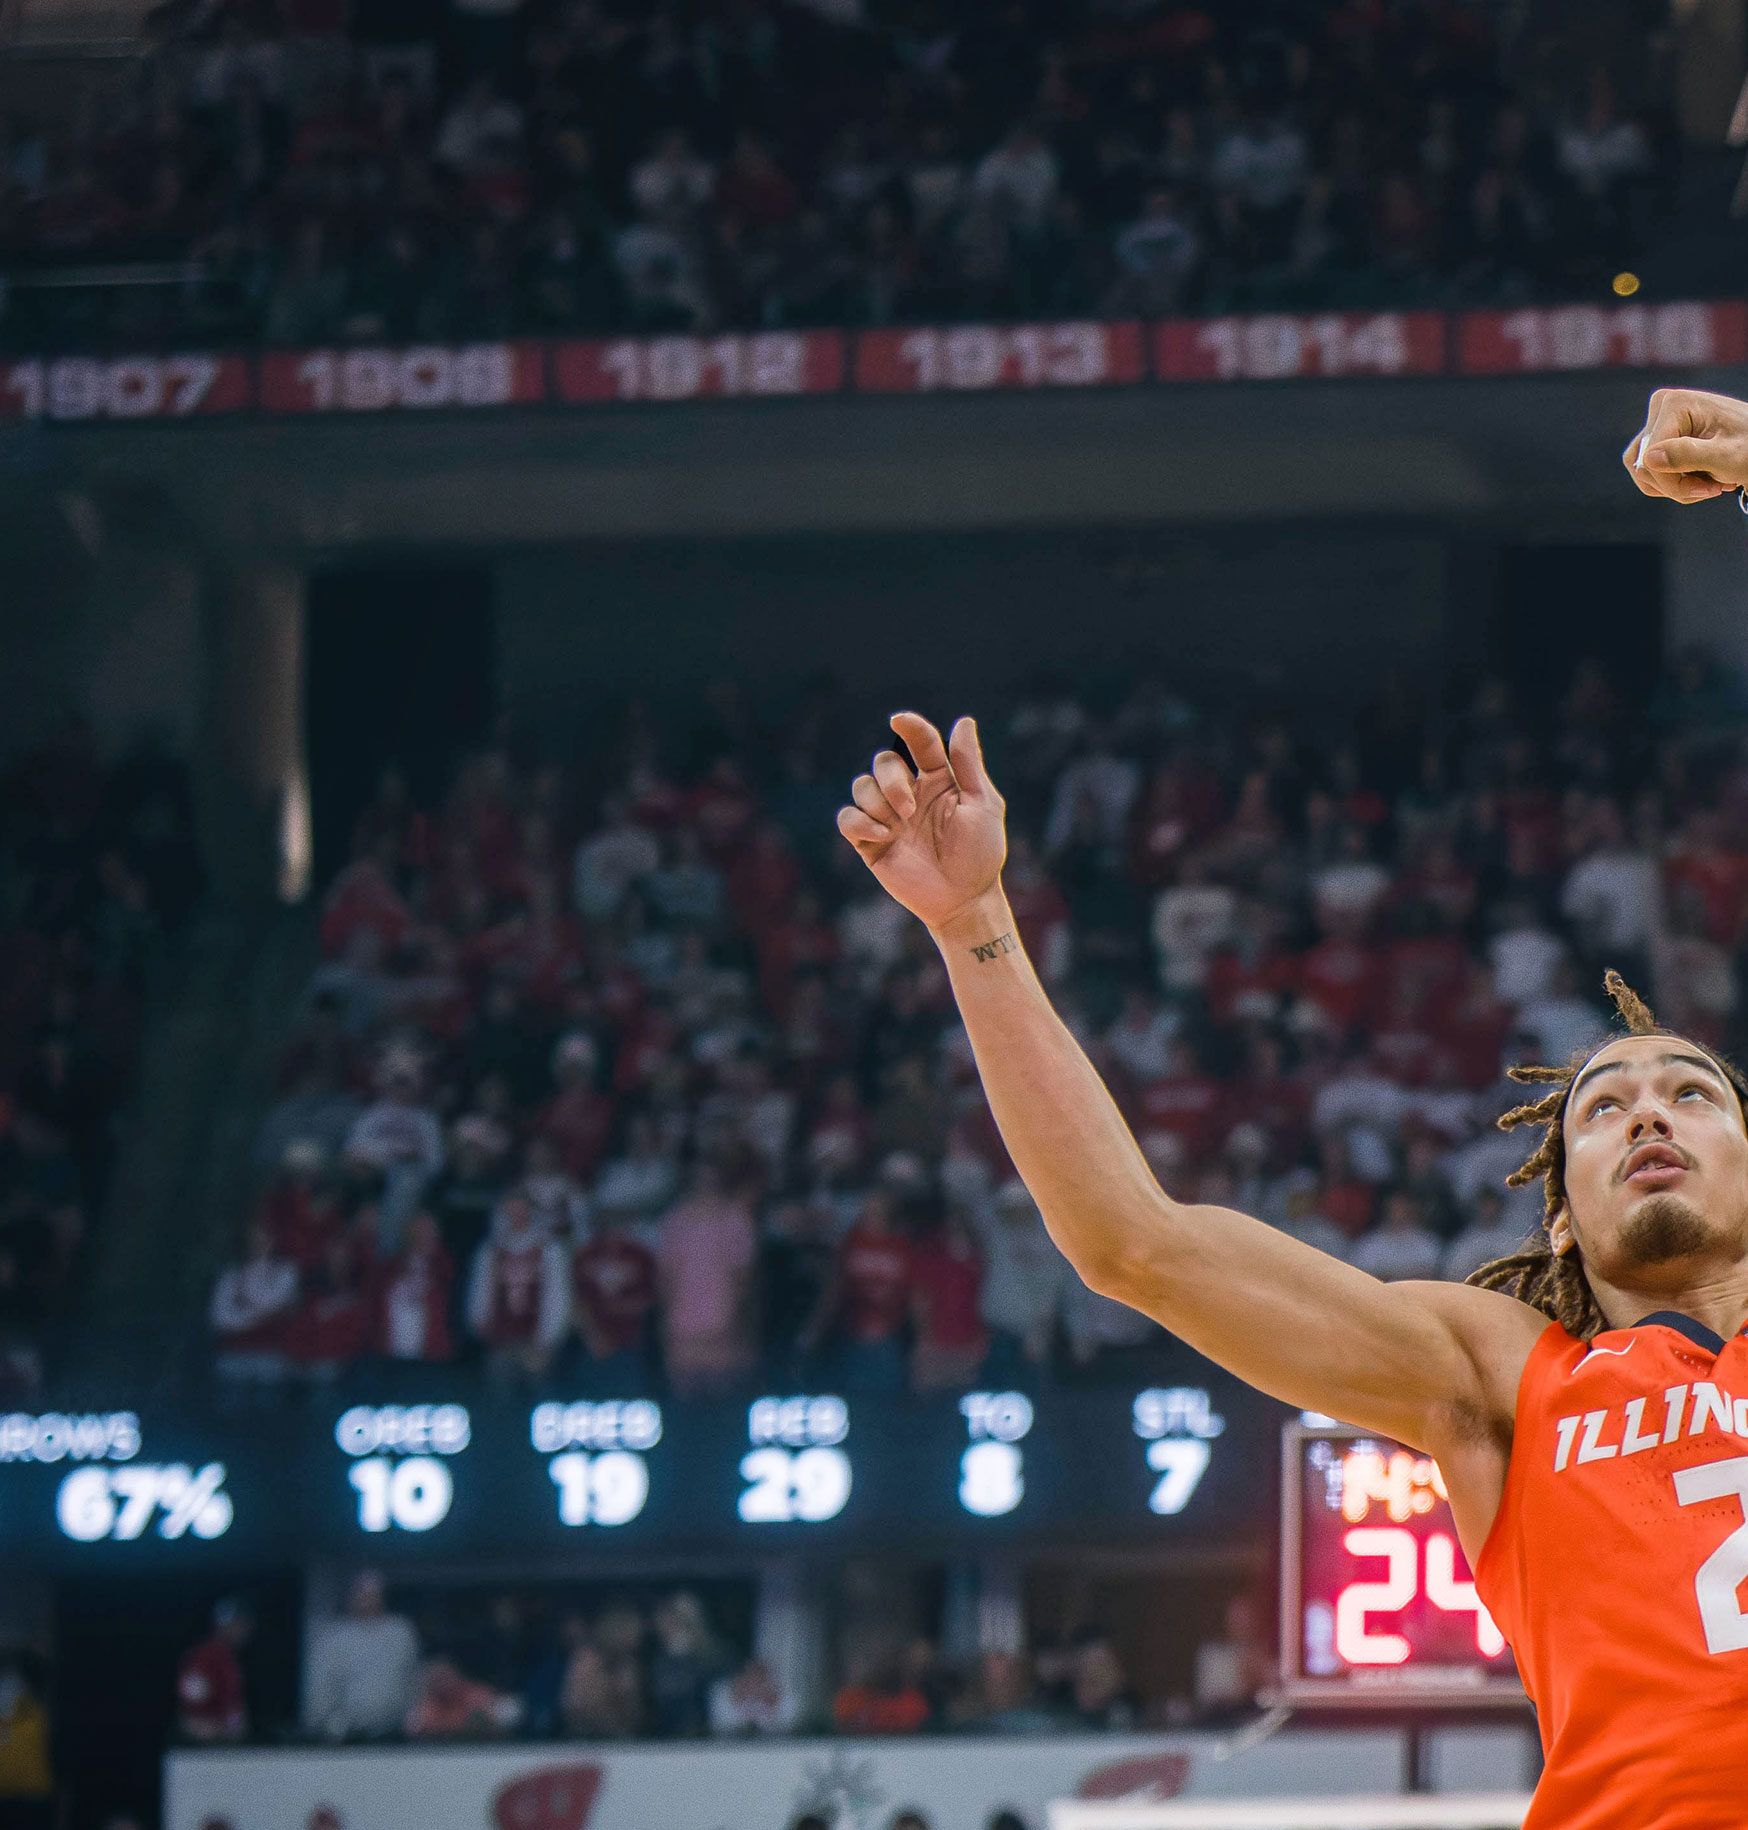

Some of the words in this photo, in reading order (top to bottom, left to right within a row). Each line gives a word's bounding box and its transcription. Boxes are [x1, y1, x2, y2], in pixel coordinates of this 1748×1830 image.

[902, 326, 1107, 388] 1913
[1202, 317, 1406, 376] 1914
[8, 356, 220, 418] 1907
[959, 1391, 1034, 1442] TO
[58, 1463, 233, 1542] 67%
[349, 1457, 453, 1532] 10
[549, 1450, 649, 1526] 19
[738, 1447, 852, 1522] 29
[959, 1441, 1024, 1516] 8
[1147, 1438, 1211, 1514] 7
[1336, 1527, 1506, 1664] 24
